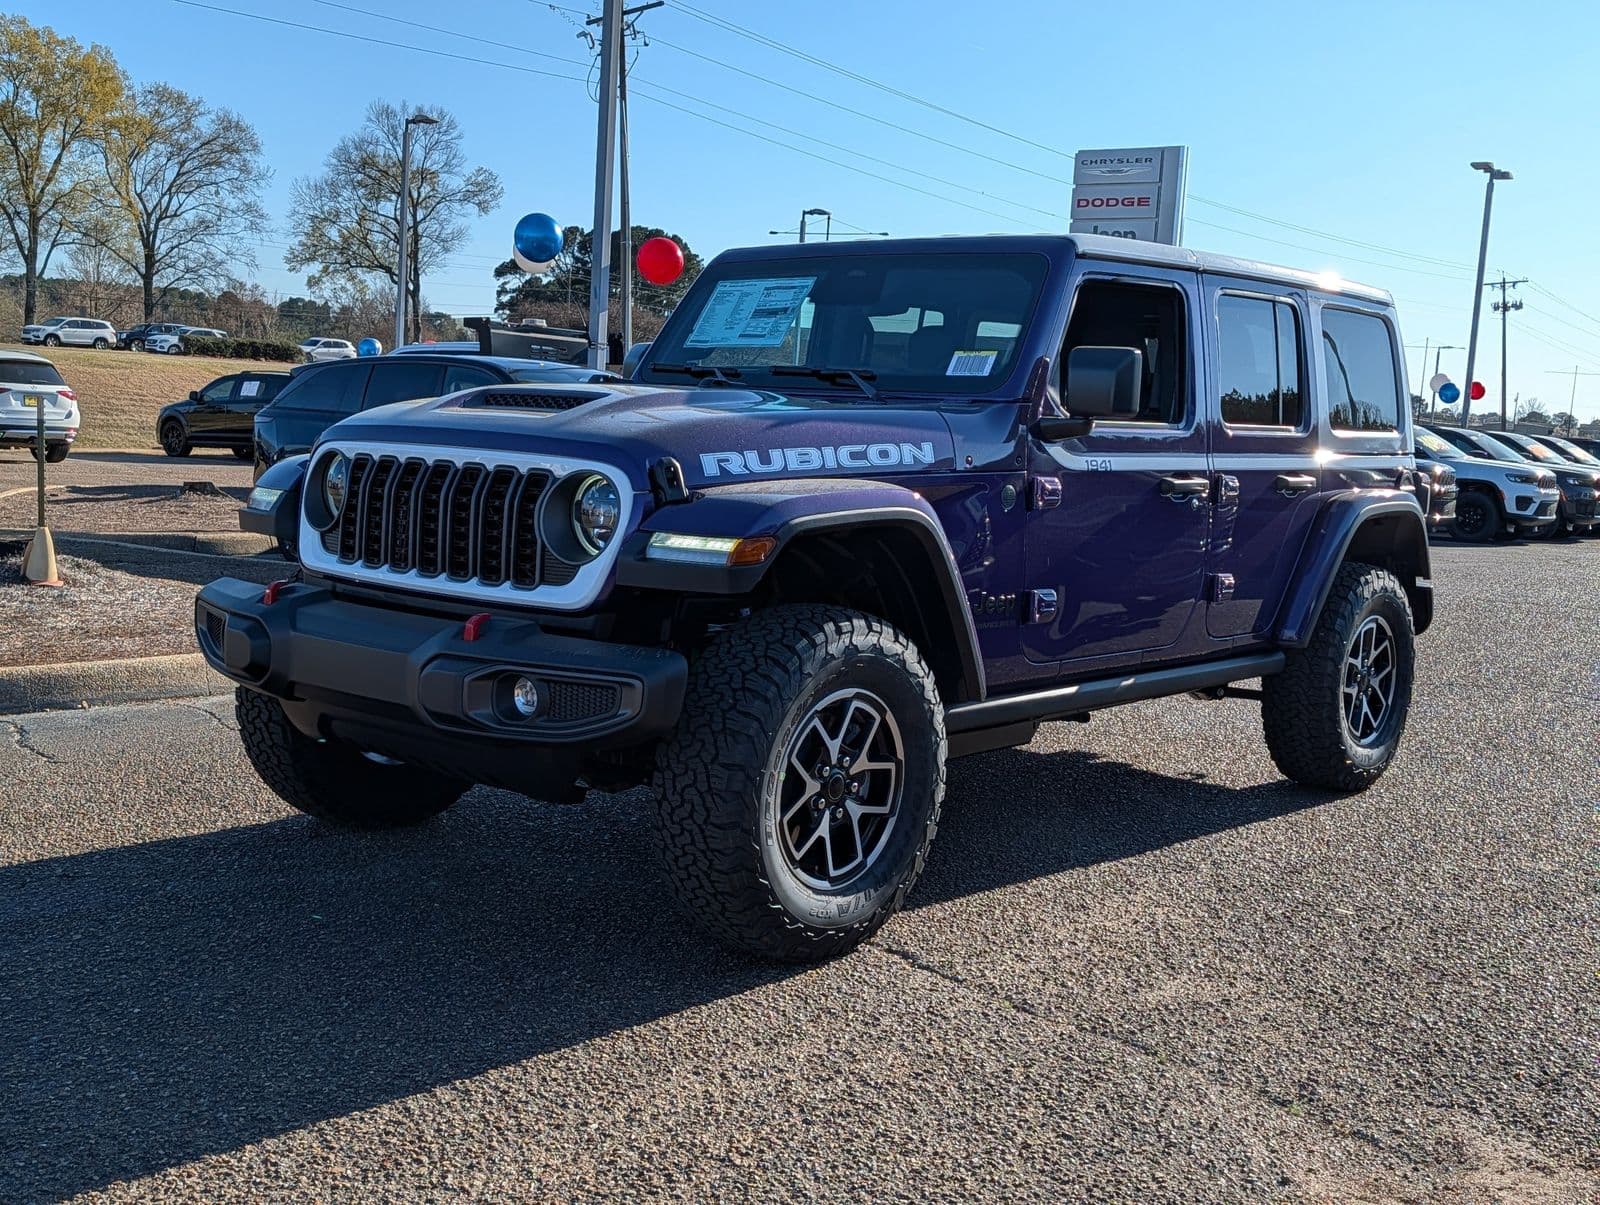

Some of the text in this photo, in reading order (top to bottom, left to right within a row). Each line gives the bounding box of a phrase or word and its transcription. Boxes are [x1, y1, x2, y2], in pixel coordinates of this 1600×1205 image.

[1081, 157, 1153, 166] CHRYSLER
[1076, 196, 1151, 208] DODGE
[699, 441, 935, 477] RUBICON
[1085, 459, 1112, 472] 1941
